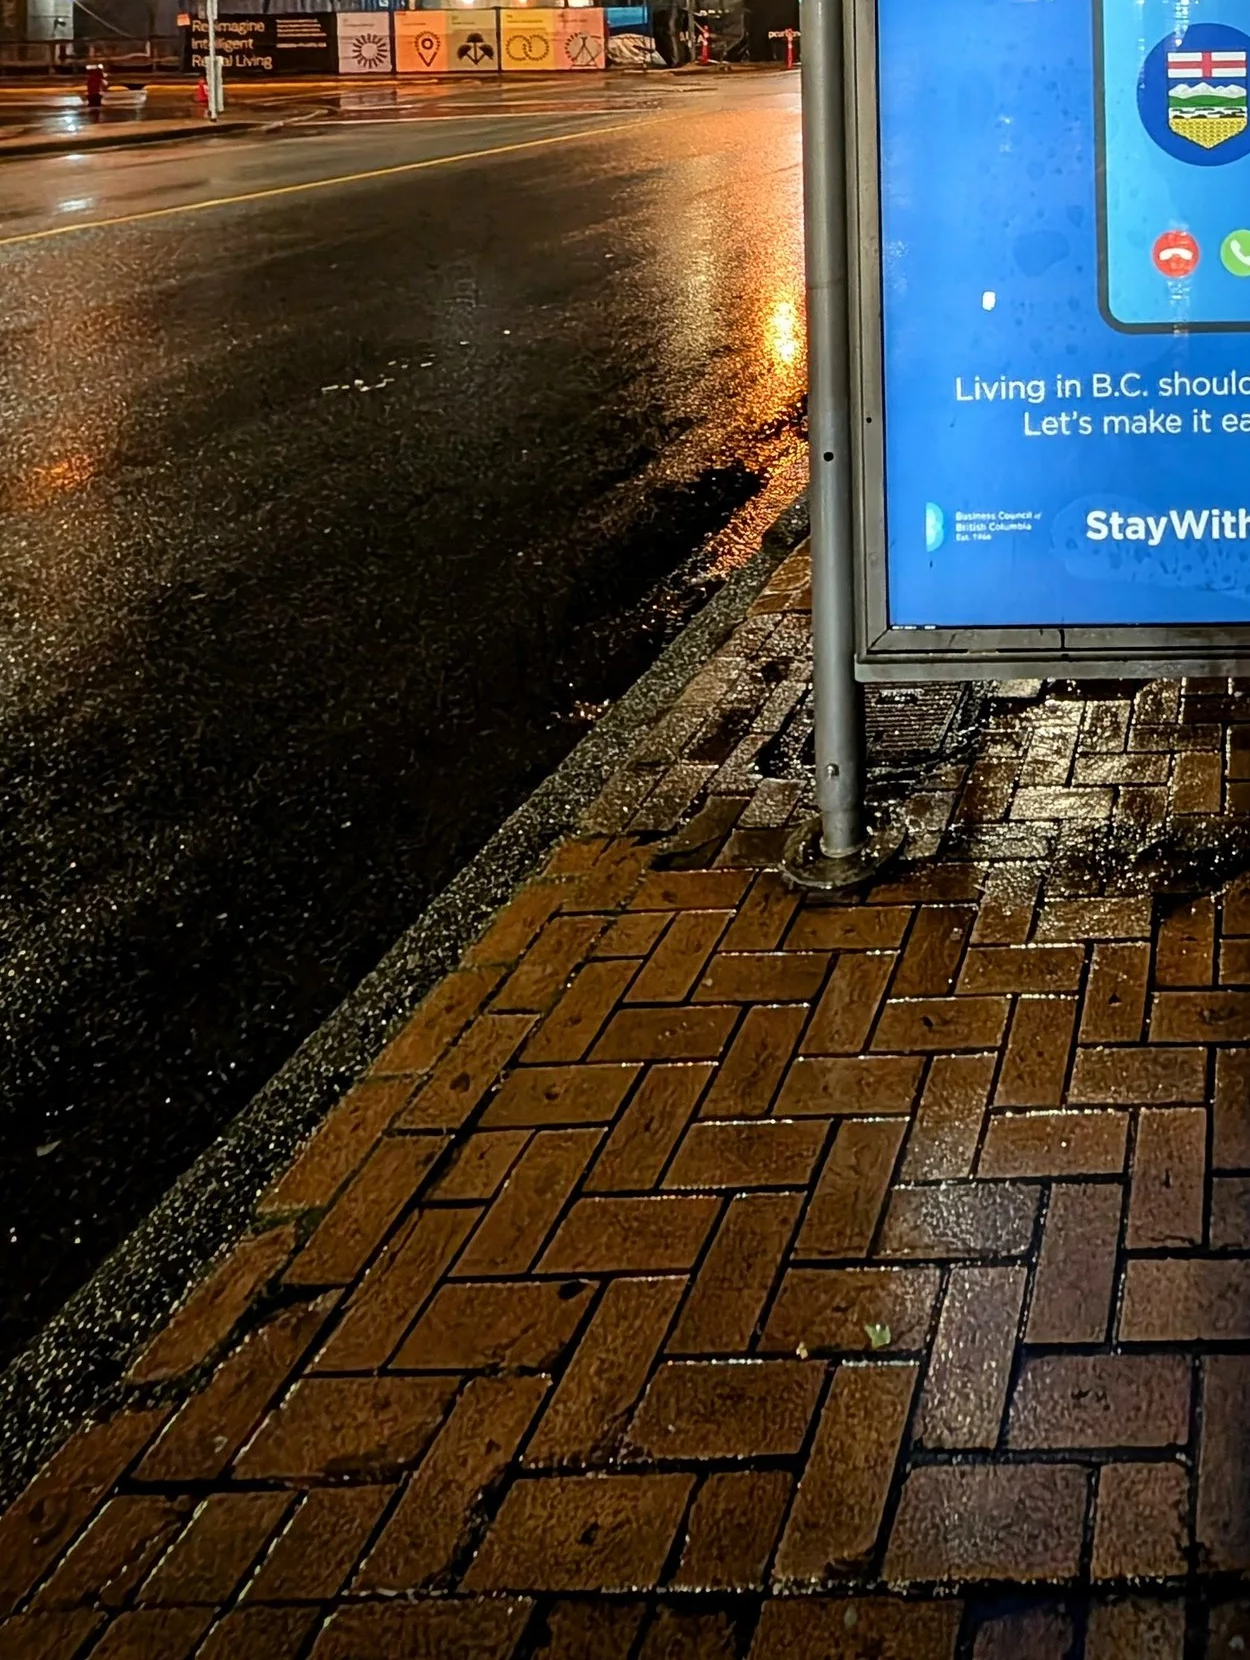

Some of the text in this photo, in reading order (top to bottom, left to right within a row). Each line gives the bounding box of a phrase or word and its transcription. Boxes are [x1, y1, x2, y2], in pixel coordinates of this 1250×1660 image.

[235, 54, 273, 70] Living
[955, 375, 1046, 404] Living
[1056, 373, 1082, 398] in
[1092, 372, 1148, 398] B.C.
[1023, 411, 1093, 436] Let's
[1103, 408, 1182, 434] make
[1192, 408, 1212, 433] it
[955, 510, 997, 521] Business
[998, 510, 1033, 520] Council
[955, 522, 1032, 533] British Columbia
